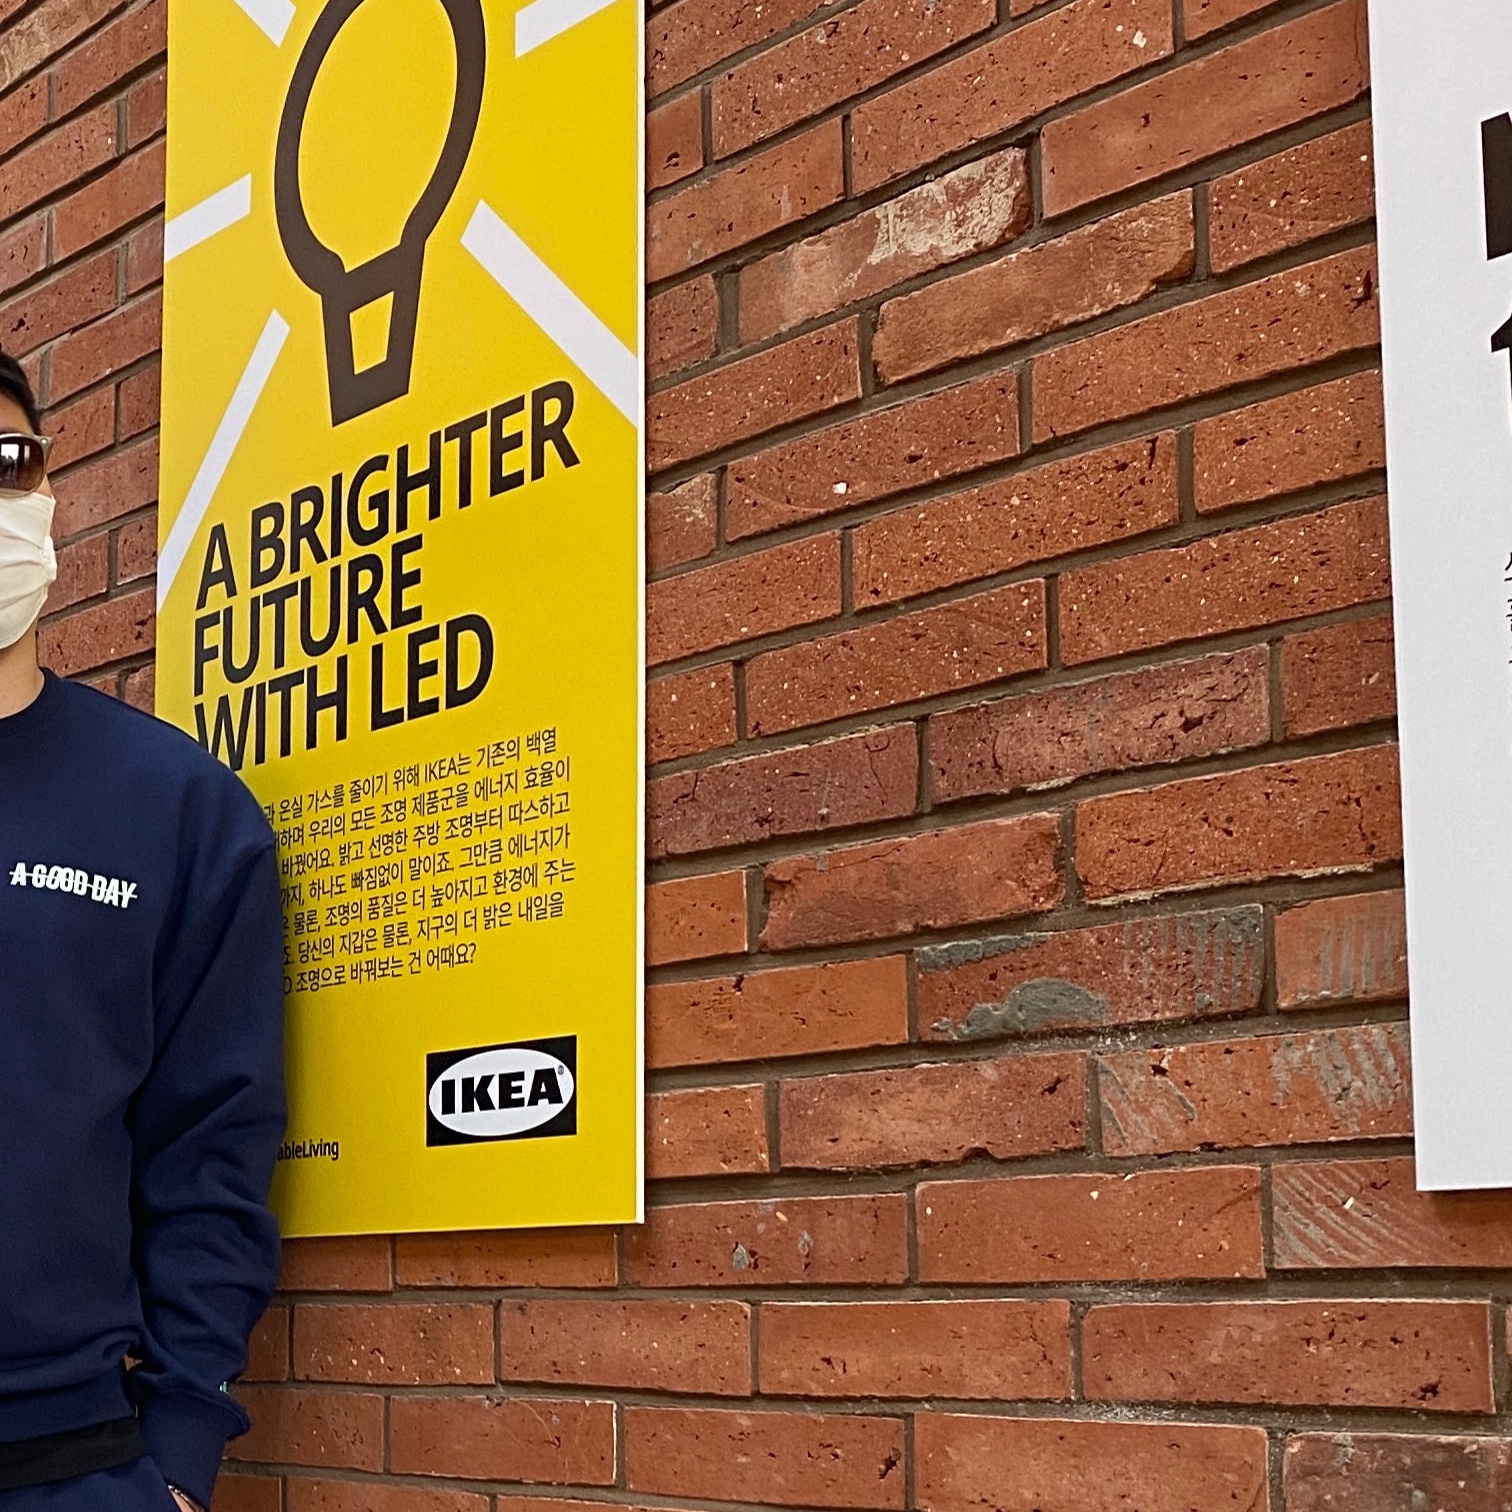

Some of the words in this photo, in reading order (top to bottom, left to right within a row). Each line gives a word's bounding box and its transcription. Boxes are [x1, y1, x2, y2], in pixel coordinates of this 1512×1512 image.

[195, 522, 238, 611] A
[250, 380, 581, 590] BRIGHTER
[193, 534, 424, 698] FUTURE
[193, 653, 348, 772] WITH
[370, 612, 495, 732] LED
[279, 794, 304, 822] 온실
[307, 783, 345, 813] 가스를
[349, 772, 389, 804] 줄이기
[393, 762, 420, 791] 위해
[424, 752, 472, 783] IKEA는
[476, 736, 521, 769] 기존의
[526, 726, 557, 756] 백열
[308, 812, 346, 844] 우리의
[350, 805, 377, 832] 모든
[380, 797, 408, 824] 조명
[411, 782, 470, 817] 제품군을
[474, 769, 519, 802] 에너지
[523, 755, 571, 790] 효율이
[309, 873, 348, 901] 하나도
[351, 859, 404, 892] 빠짐없이
[408, 850, 455, 882] 말이죠.
[459, 838, 504, 868] 그만큼
[508, 822, 571, 859] 에너지가
[339, 840, 365, 866] 밝고
[369, 828, 409, 859] 선명한
[412, 819, 441, 849] 주방
[444, 805, 504, 840] 조명부터
[508, 791, 571, 827] 따스하고
[10, 862, 28, 887] A
[31, 863, 89, 896] GOOD
[91, 874, 138, 909] DAY
[324, 899, 364, 928] 조명의
[367, 890, 409, 921] 품질은
[412, 885, 426, 911] 더
[430, 875, 489, 908] 높아지고
[493, 862, 539, 896] 환경에
[543, 857, 577, 886] 주는
[298, 934, 336, 964] 당신의
[339, 927, 379, 956] 지갑은
[417, 910, 458, 942] 지구의
[464, 906, 477, 933] 더
[483, 901, 513, 931] 밝은
[518, 891, 565, 922] 내일을
[296, 965, 347, 993] 조명으로
[350, 954, 405, 985] 바꿔보는
[408, 949, 422, 975] 건
[426, 942, 477, 972] 어때요?
[440, 1066, 565, 1116] IKEA
